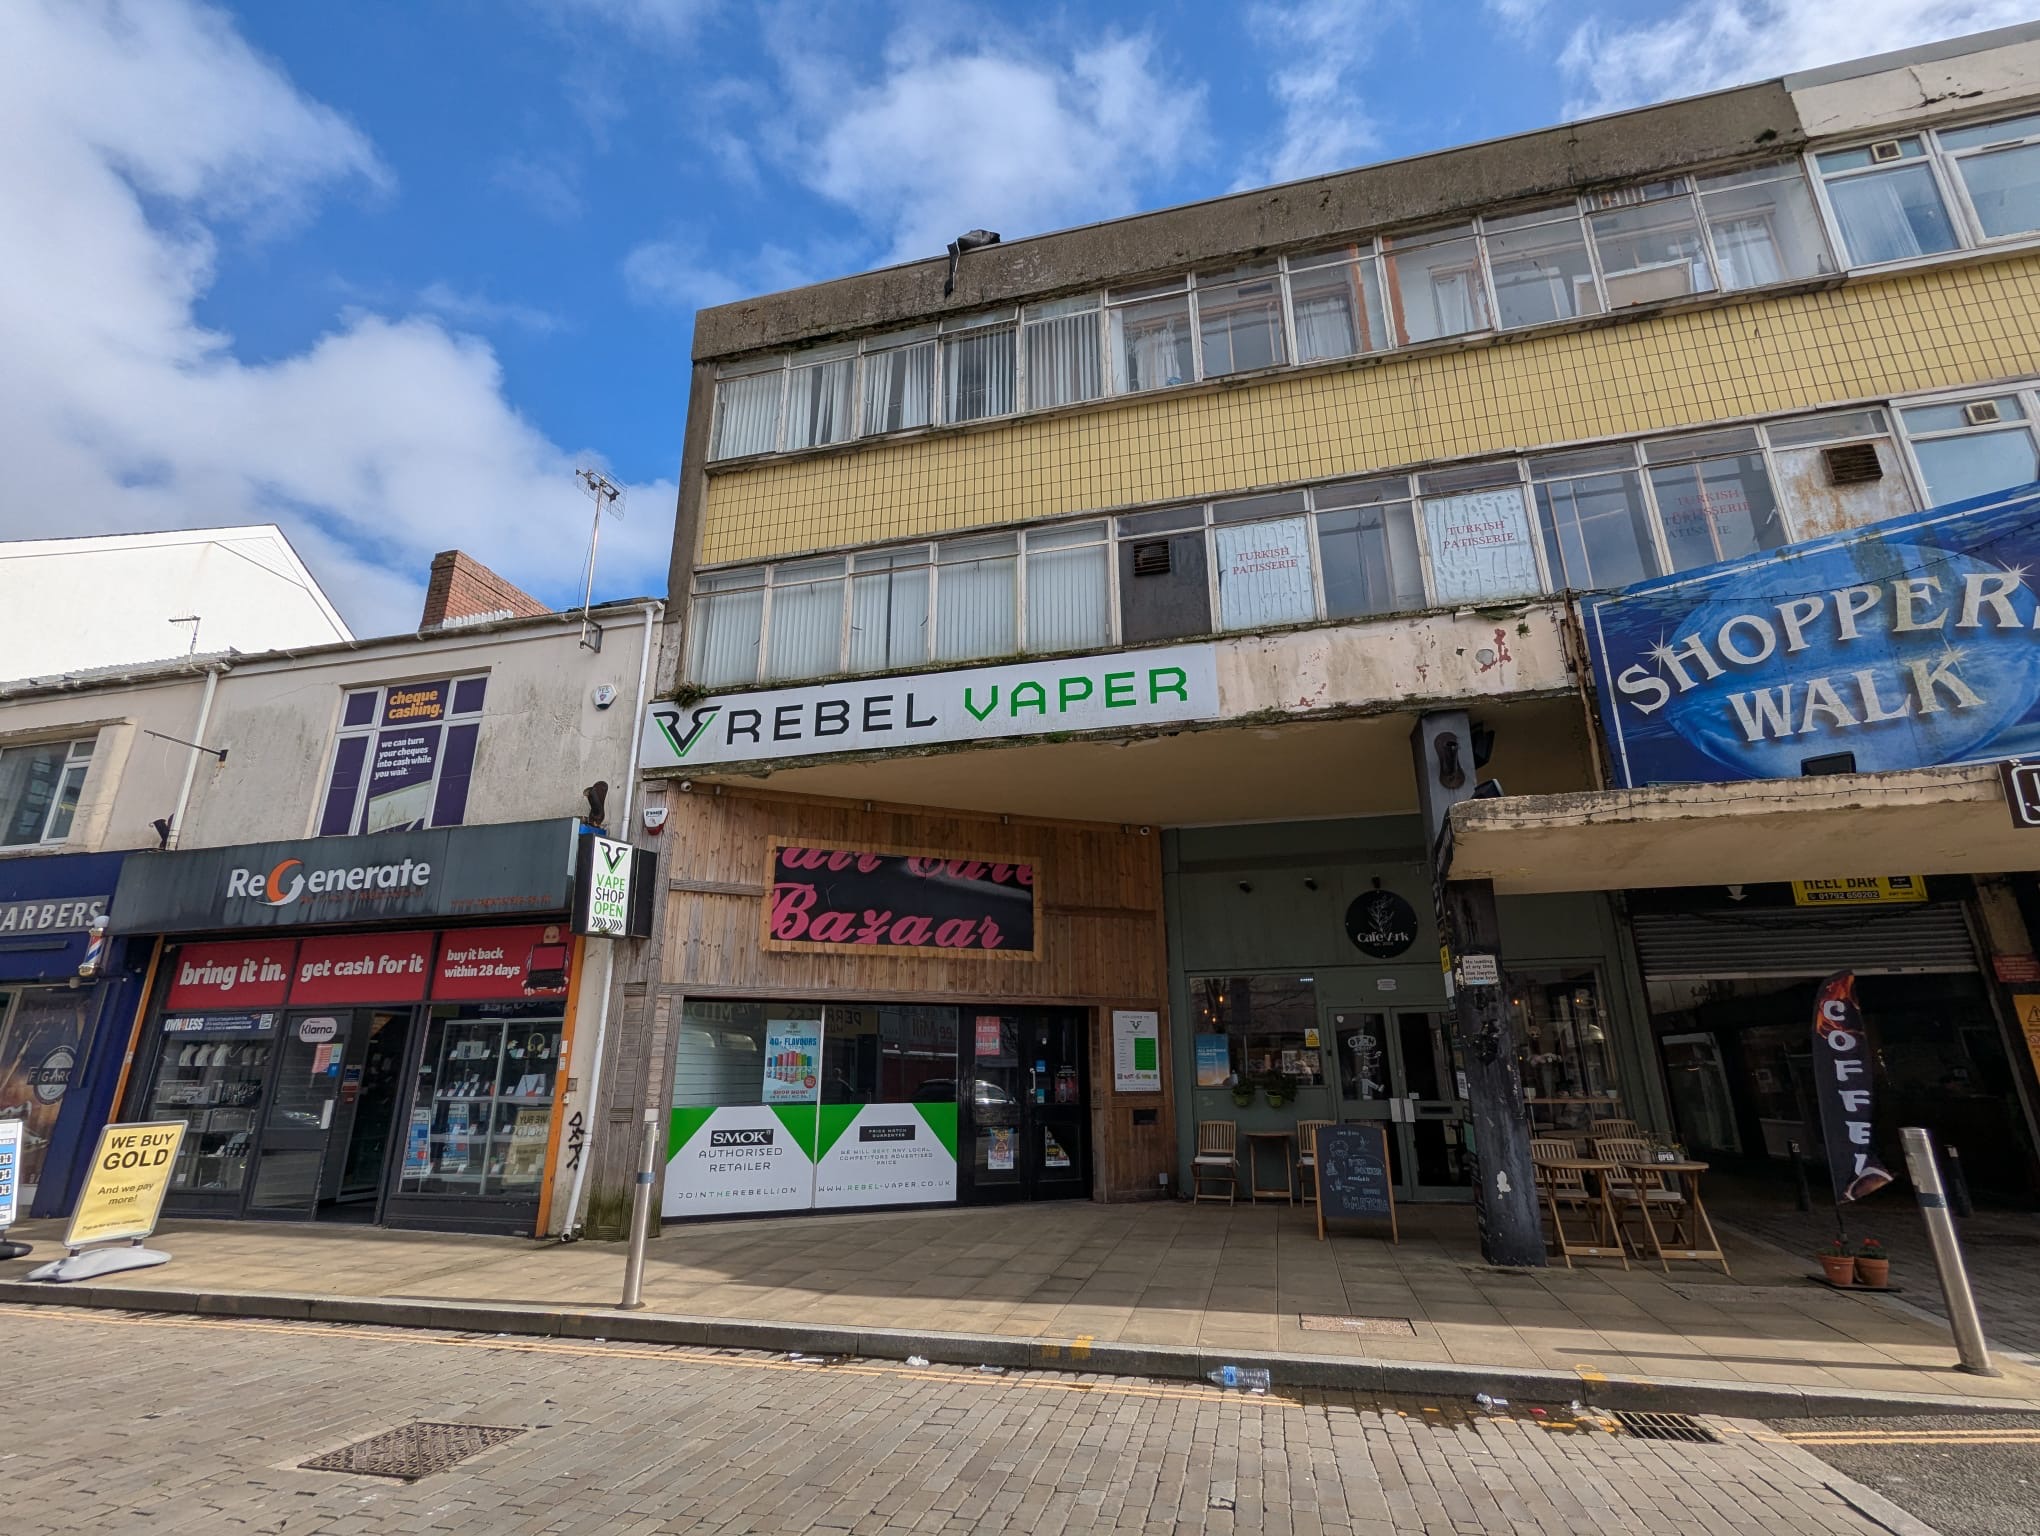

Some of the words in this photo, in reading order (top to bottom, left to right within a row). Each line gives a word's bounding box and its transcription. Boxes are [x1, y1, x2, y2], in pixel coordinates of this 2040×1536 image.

[1446, 520, 1505, 535] TURKISH
[1442, 532, 1515, 550] PATISSERIE
[1236, 546, 1289, 562] TURKISH
[1232, 559, 1297, 575] PATISSERIE
[1617, 572, 2040, 714] SHOPPER
[390, 690, 438, 706] cheque
[726, 692, 938, 745] REBEL
[964, 666, 1188, 722] VAPER
[1726, 656, 1986, 742] WALK
[388, 702, 442, 719] cashing.
[393, 739, 406, 747] can
[407, 737, 424, 746] turn
[376, 760, 392, 768] into
[392, 757, 410, 767] cash
[410, 755, 431, 765] while
[379, 750, 396, 760] your
[397, 747, 429, 757] cheques
[374, 770, 389, 780] you
[775, 847, 883, 873] air
[597, 873, 625, 891] VAPE
[595, 887, 624, 904] SHOP
[0, 901, 103, 931] ARBERS
[594, 901, 623, 918] OPEN
[770, 882, 1004, 949] Bazaar
[447, 948, 468, 964] buy
[468, 947, 477, 960] it
[477, 947, 504, 960] back
[179, 959, 237, 991] bring
[239, 957, 258, 983] it
[259, 956, 287, 982] in.
[300, 959, 332, 983] get
[334, 955, 374, 976] cash
[377, 954, 407, 974] for
[408, 953, 424, 973] it
[444, 964, 478, 978] within
[478, 964, 493, 977] 28
[494, 963, 520, 979] days
[784, 1037, 817, 1046] FLAVOURS
[111, 1135, 137, 1149] WE
[140, 1133, 175, 1147] BUY
[713, 1130, 768, 1144] SMOK
[103, 1149, 168, 1170] GOLD
[698, 1147, 783, 1159] AUTHORISED
[709, 1161, 771, 1173] RETAILER
[97, 1185, 119, 1195] And
[121, 1185, 136, 1193] we
[136, 1182, 154, 1194] pay
[678, 1186, 797, 1199] JOINTHEREBELLION
